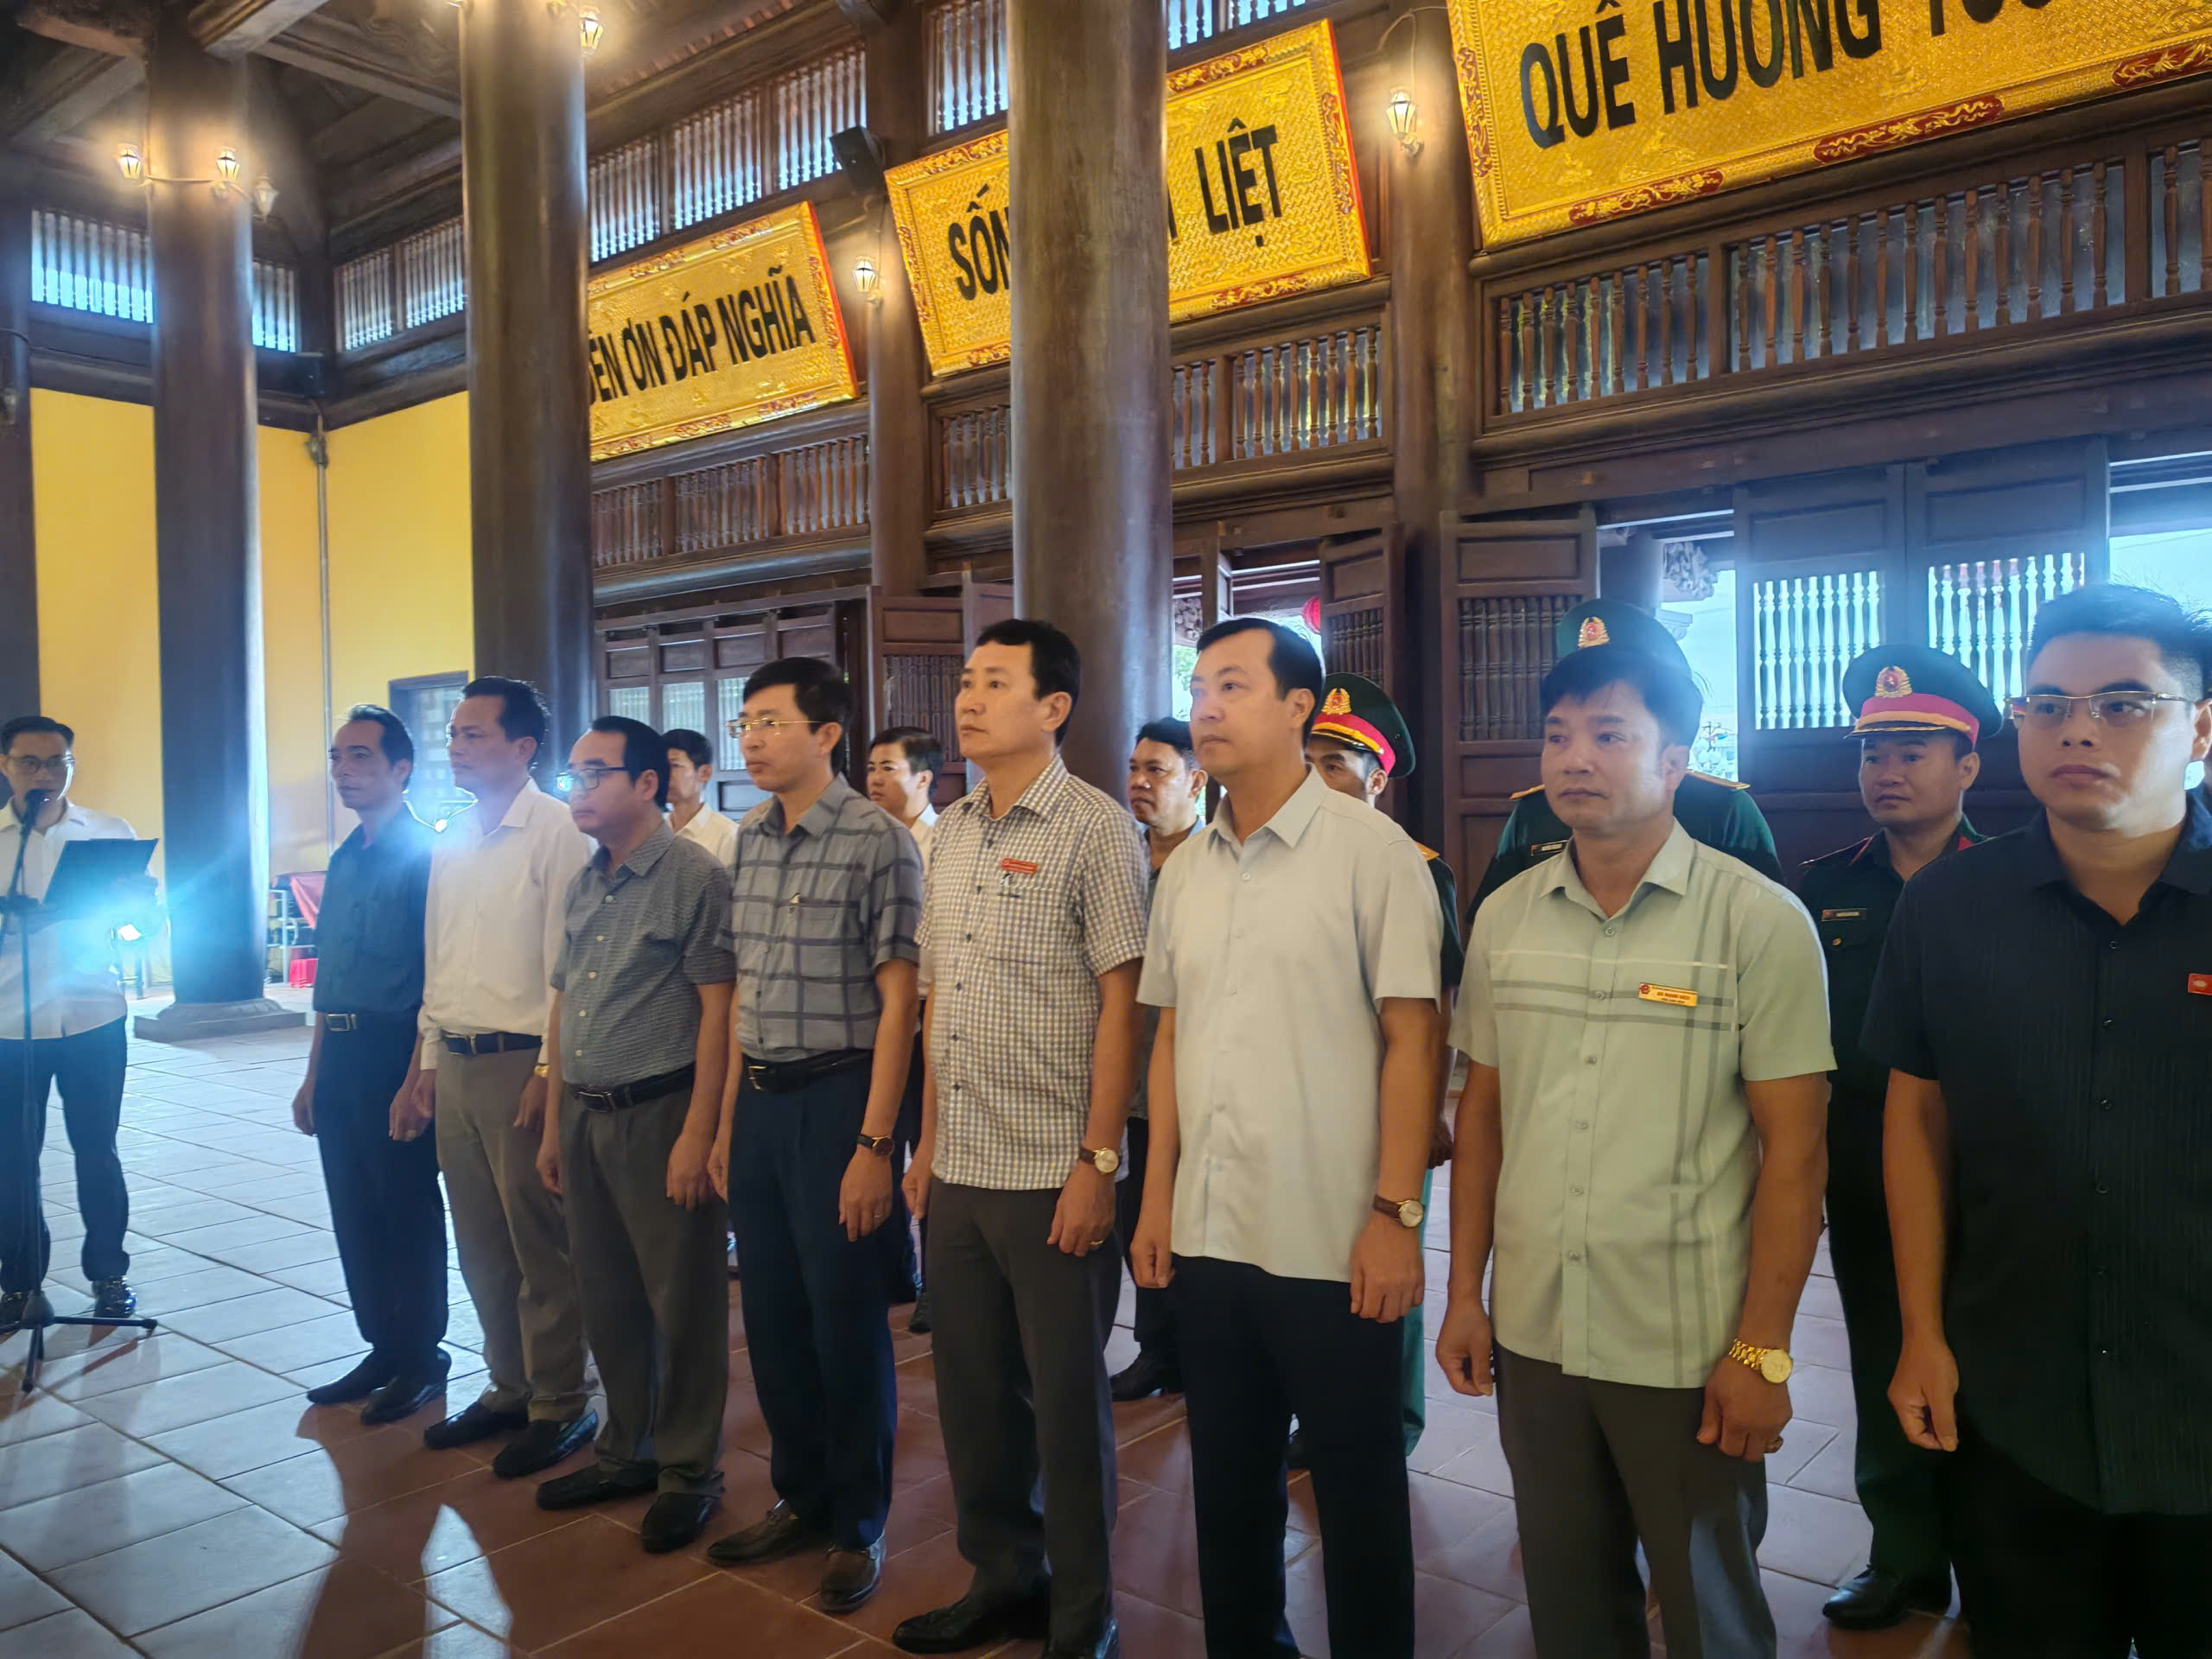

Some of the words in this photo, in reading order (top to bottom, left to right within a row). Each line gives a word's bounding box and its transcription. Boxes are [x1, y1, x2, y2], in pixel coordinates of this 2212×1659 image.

[1520, 0, 1636, 149] QUÊ
[948, 183, 1009, 301] SỐN
[1195, 118, 1282, 247] LIỆT
[622, 318, 666, 391] ƠN
[658, 291, 718, 381] ĐÁP
[715, 264, 816, 365] NGHĨA
